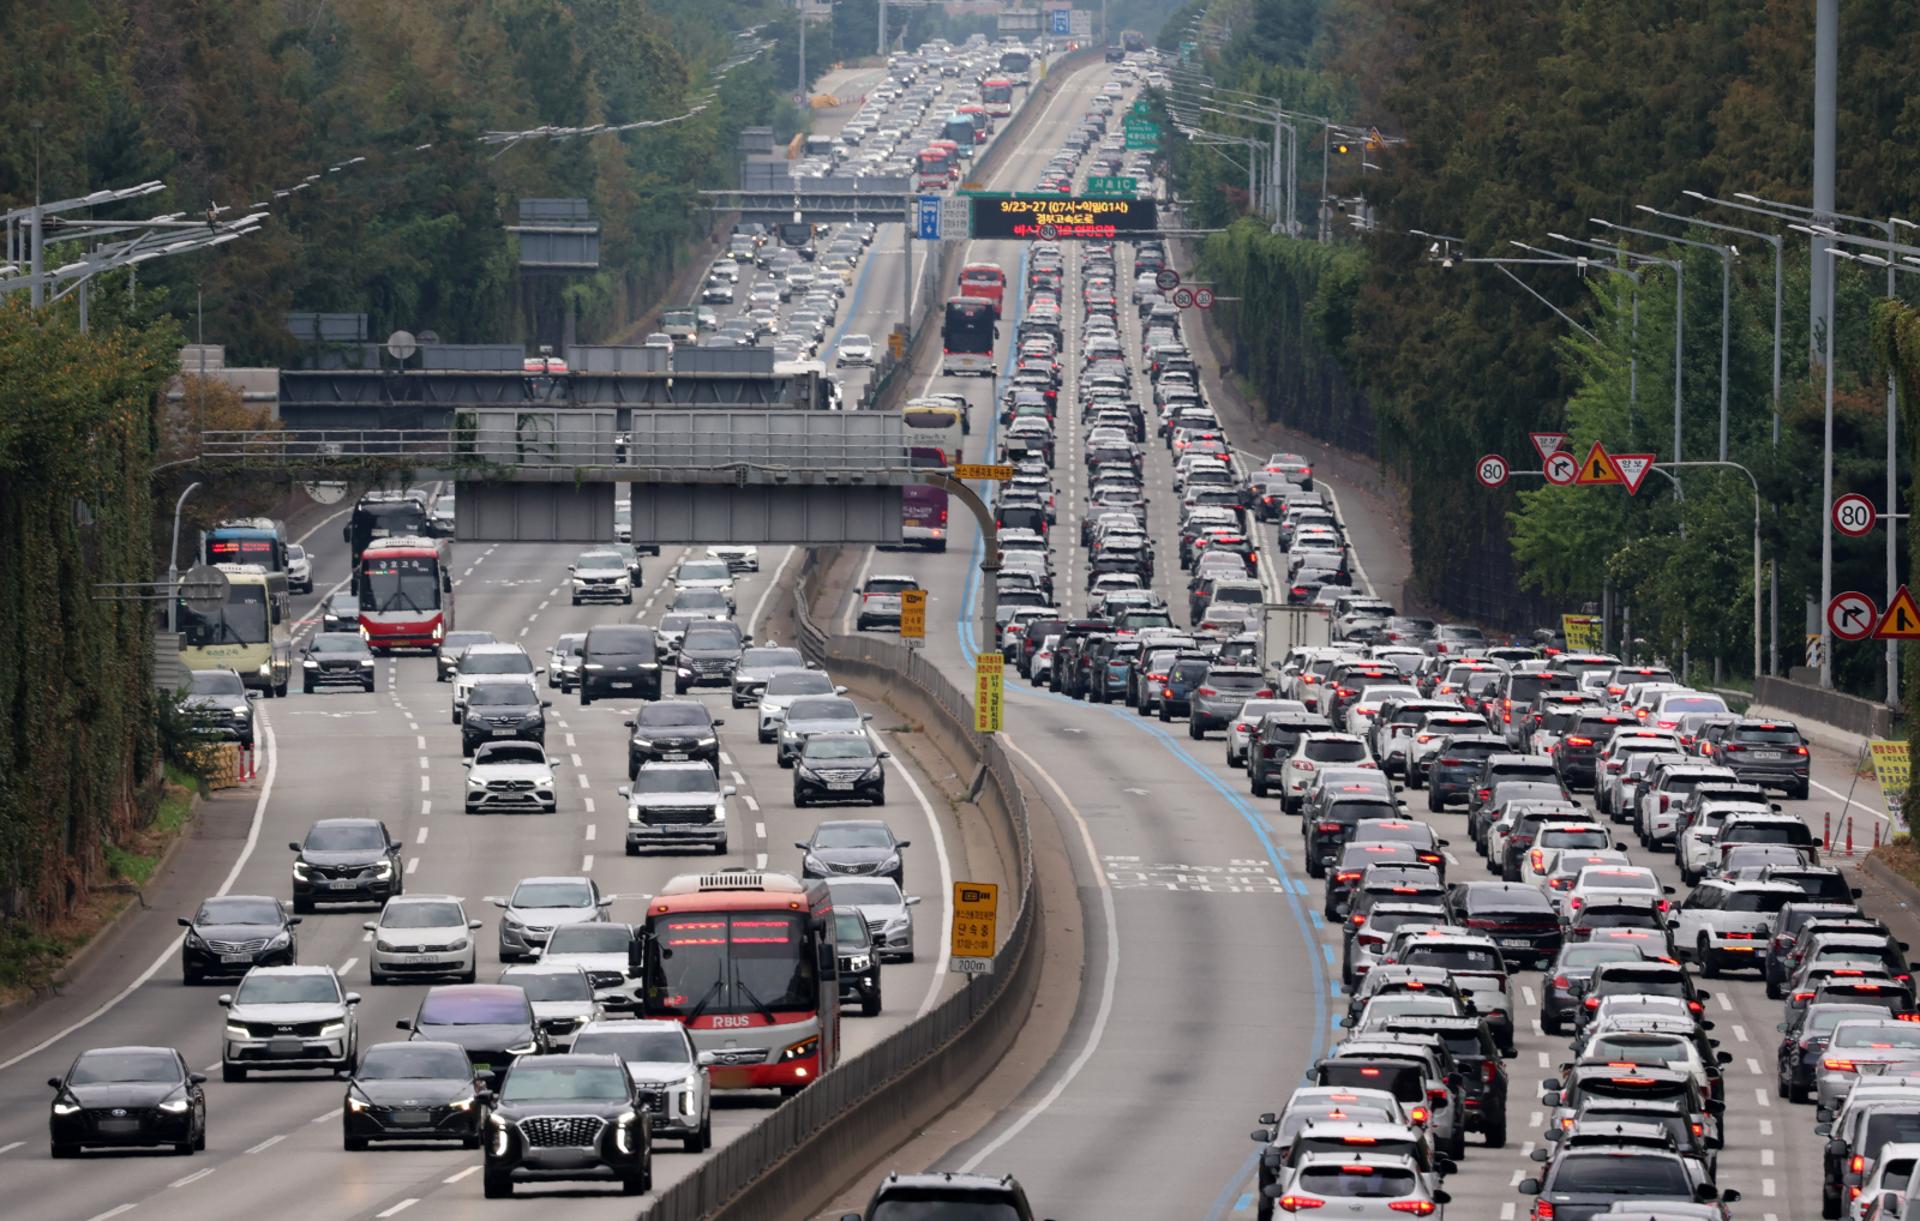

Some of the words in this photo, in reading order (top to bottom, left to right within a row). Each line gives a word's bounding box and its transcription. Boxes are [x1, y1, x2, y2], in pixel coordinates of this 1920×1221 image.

[1001, 202, 1046, 212] 9/23~27
[1036, 214, 1094, 224] 경부고속도로
[1621, 460, 1643, 468] 양보
[1483, 463, 1502, 480] 80
[1842, 505, 1868, 526] 80
[959, 960, 986, 971] 200m
